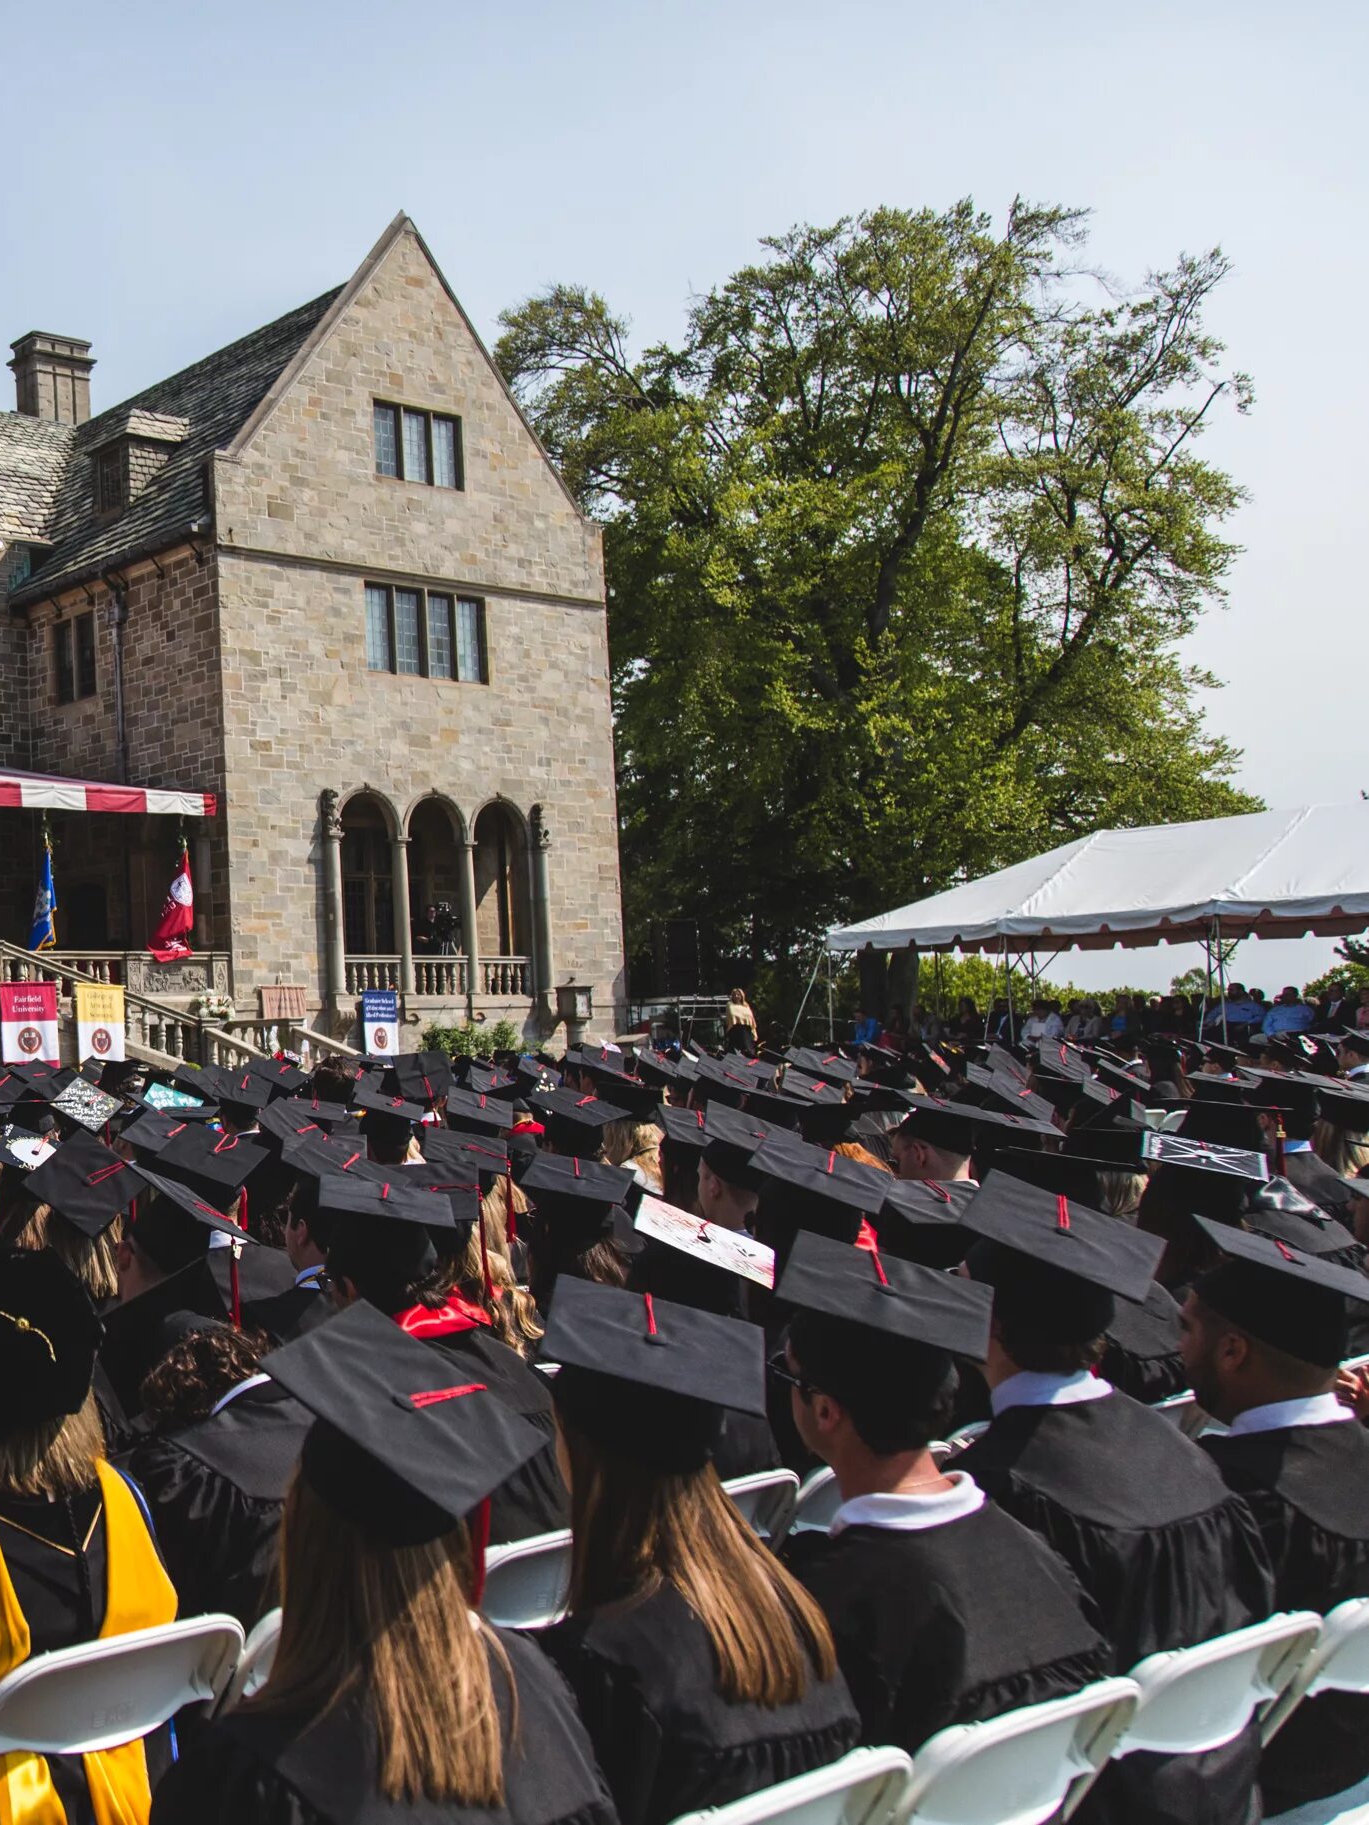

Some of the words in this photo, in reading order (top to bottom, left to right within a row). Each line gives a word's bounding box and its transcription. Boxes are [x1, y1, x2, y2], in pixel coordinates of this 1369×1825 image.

[14, 995, 42, 1004] Fairfield
[12, 1005, 45, 1015] University
[151, 1089, 174, 1099] HEY
[151, 1097, 177, 1108] OOK
